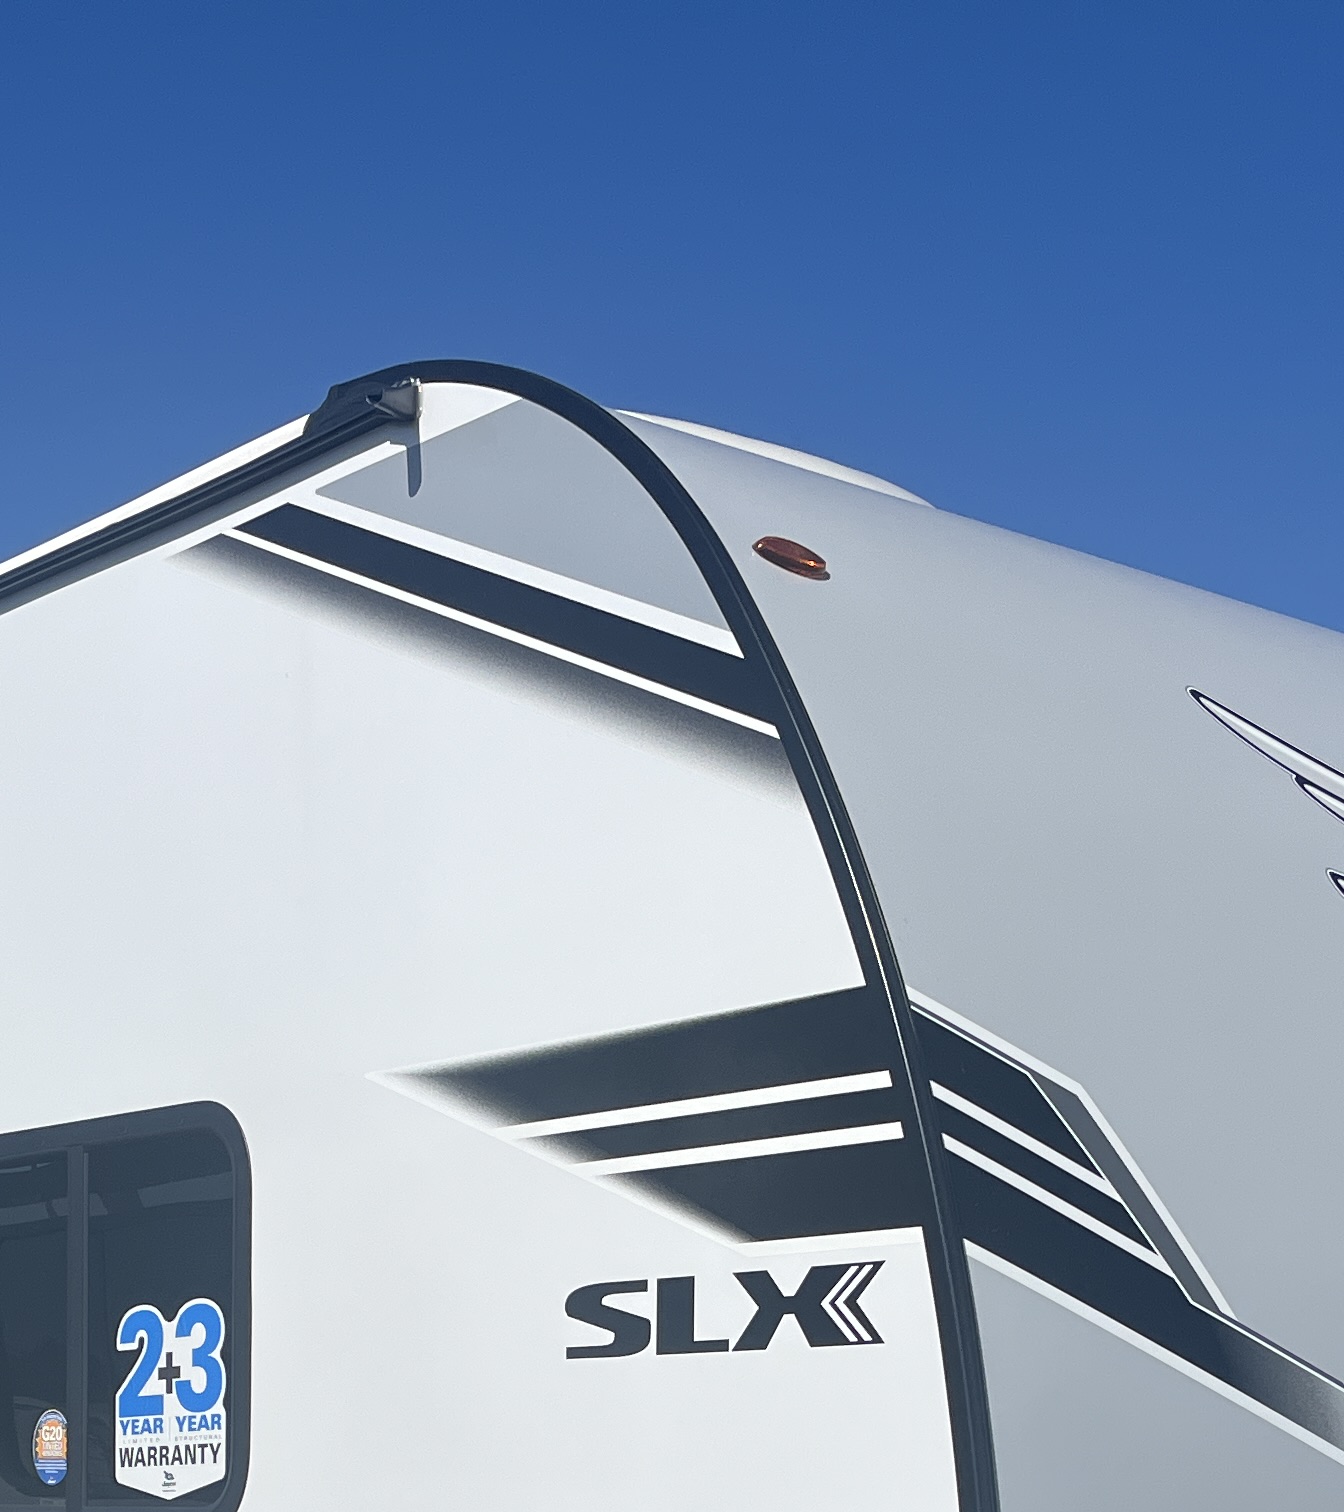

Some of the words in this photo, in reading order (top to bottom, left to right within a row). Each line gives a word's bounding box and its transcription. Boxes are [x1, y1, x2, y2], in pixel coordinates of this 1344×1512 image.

[565, 1260, 886, 1360] SLX
[119, 1417, 164, 1435] YEAR
[175, 1413, 222, 1432] YEAR
[42, 1425, 63, 1441] G20
[174, 1434, 223, 1442] STRUCTURAL
[119, 1442, 221, 1468] WARRANTY
